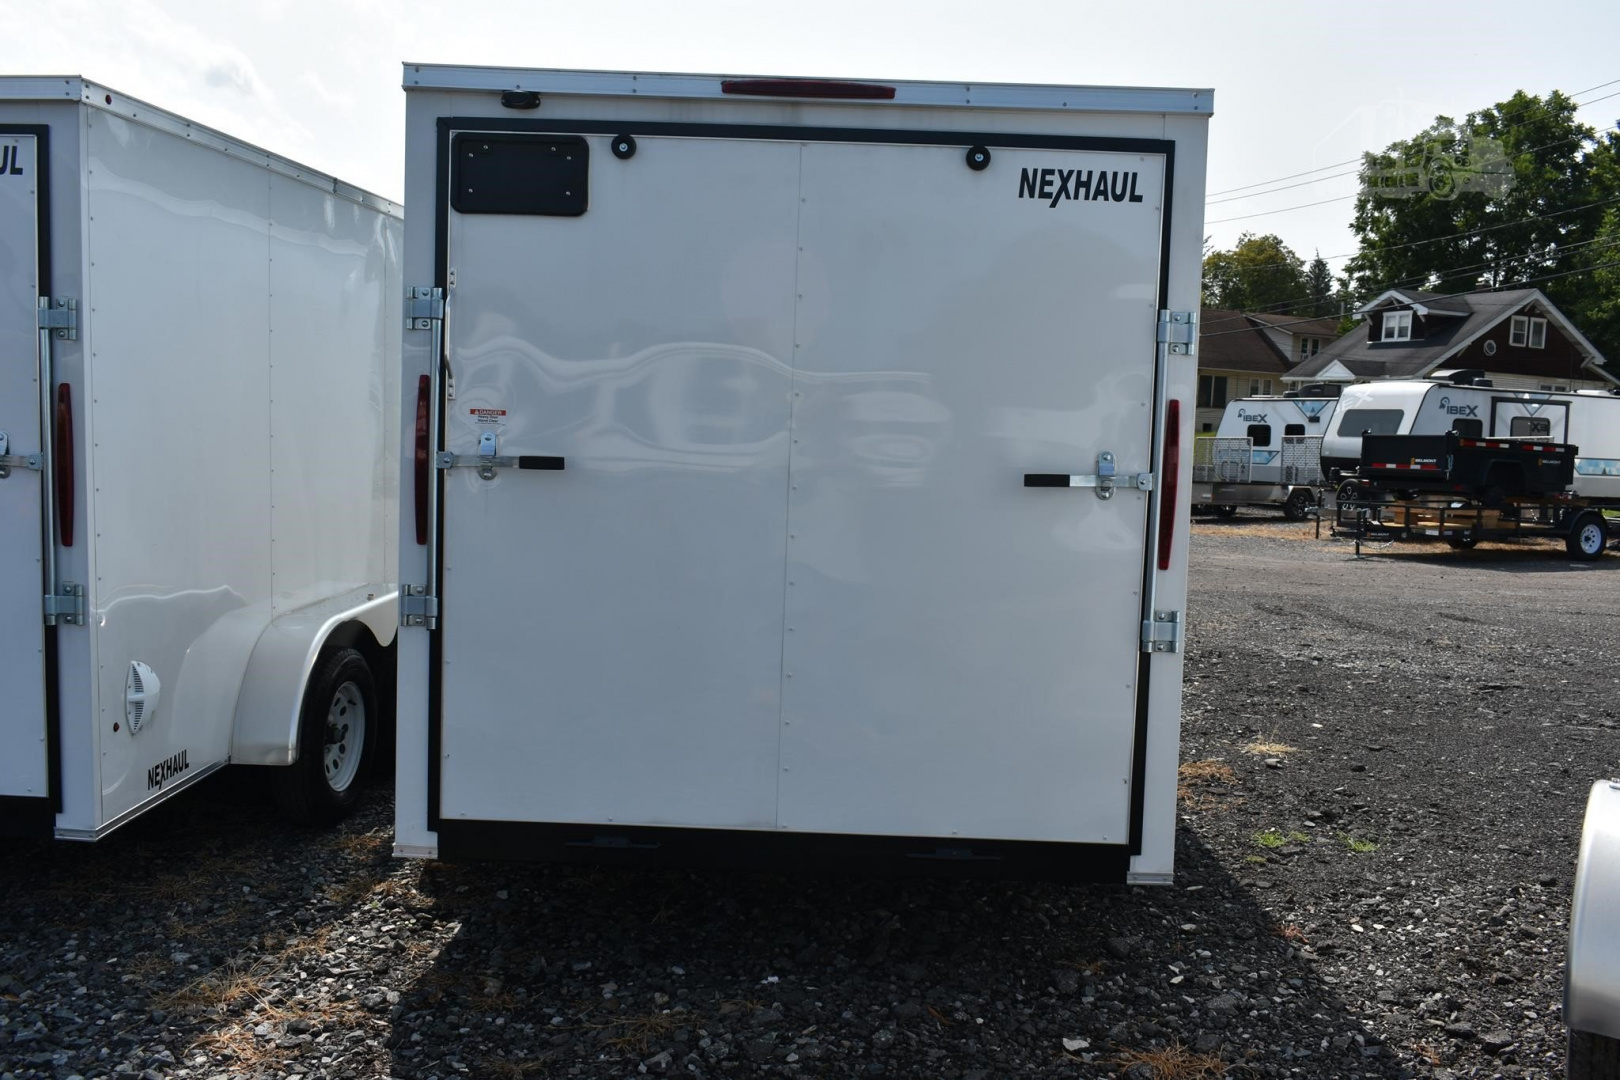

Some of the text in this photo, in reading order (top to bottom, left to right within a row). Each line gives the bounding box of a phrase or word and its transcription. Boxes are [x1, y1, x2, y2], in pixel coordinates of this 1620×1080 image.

[1018, 167, 1144, 208] NEXHAUL
[1242, 413, 1268, 423] IBEX
[1446, 404, 1479, 417] IBEX
[147, 749, 190, 790] NEXHAUL
